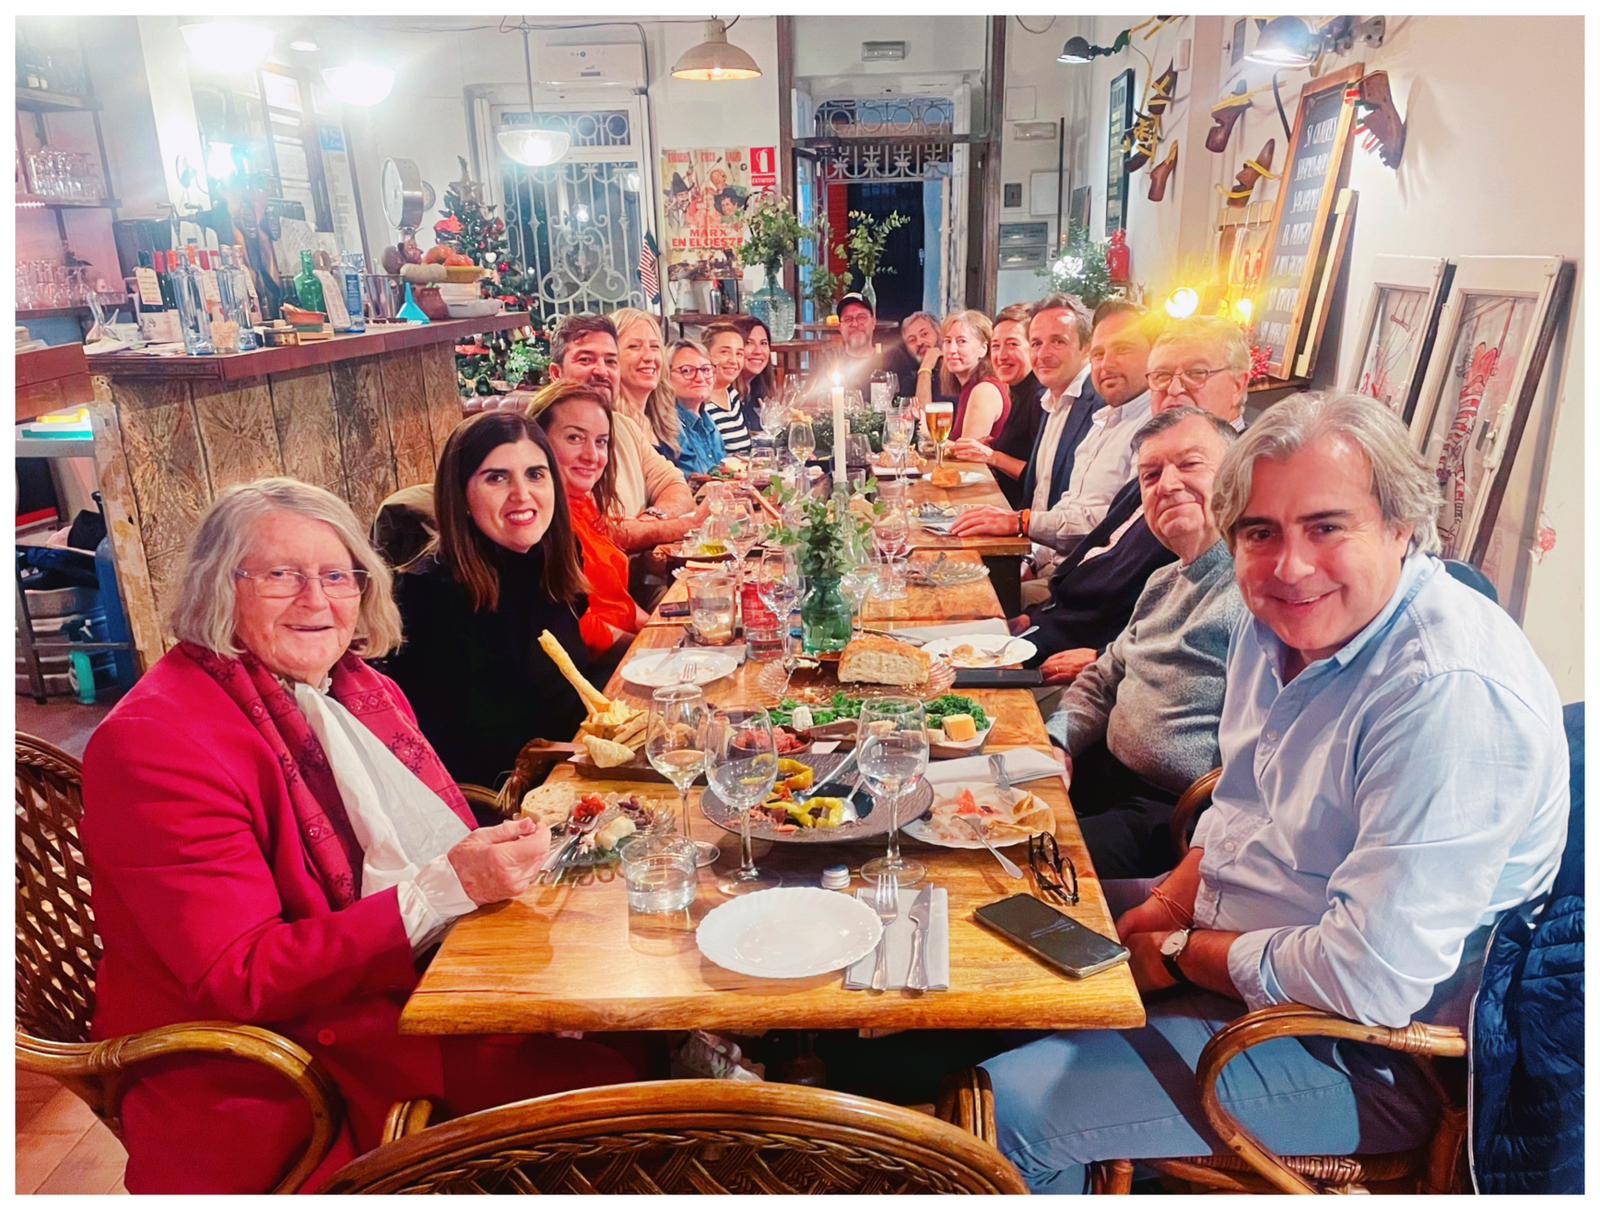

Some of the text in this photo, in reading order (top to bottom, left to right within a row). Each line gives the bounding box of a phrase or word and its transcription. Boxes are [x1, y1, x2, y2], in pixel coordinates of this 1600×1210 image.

[690, 229, 727, 237] MARX
[672, 238, 687, 248] EN
[689, 238, 702, 248] EL
